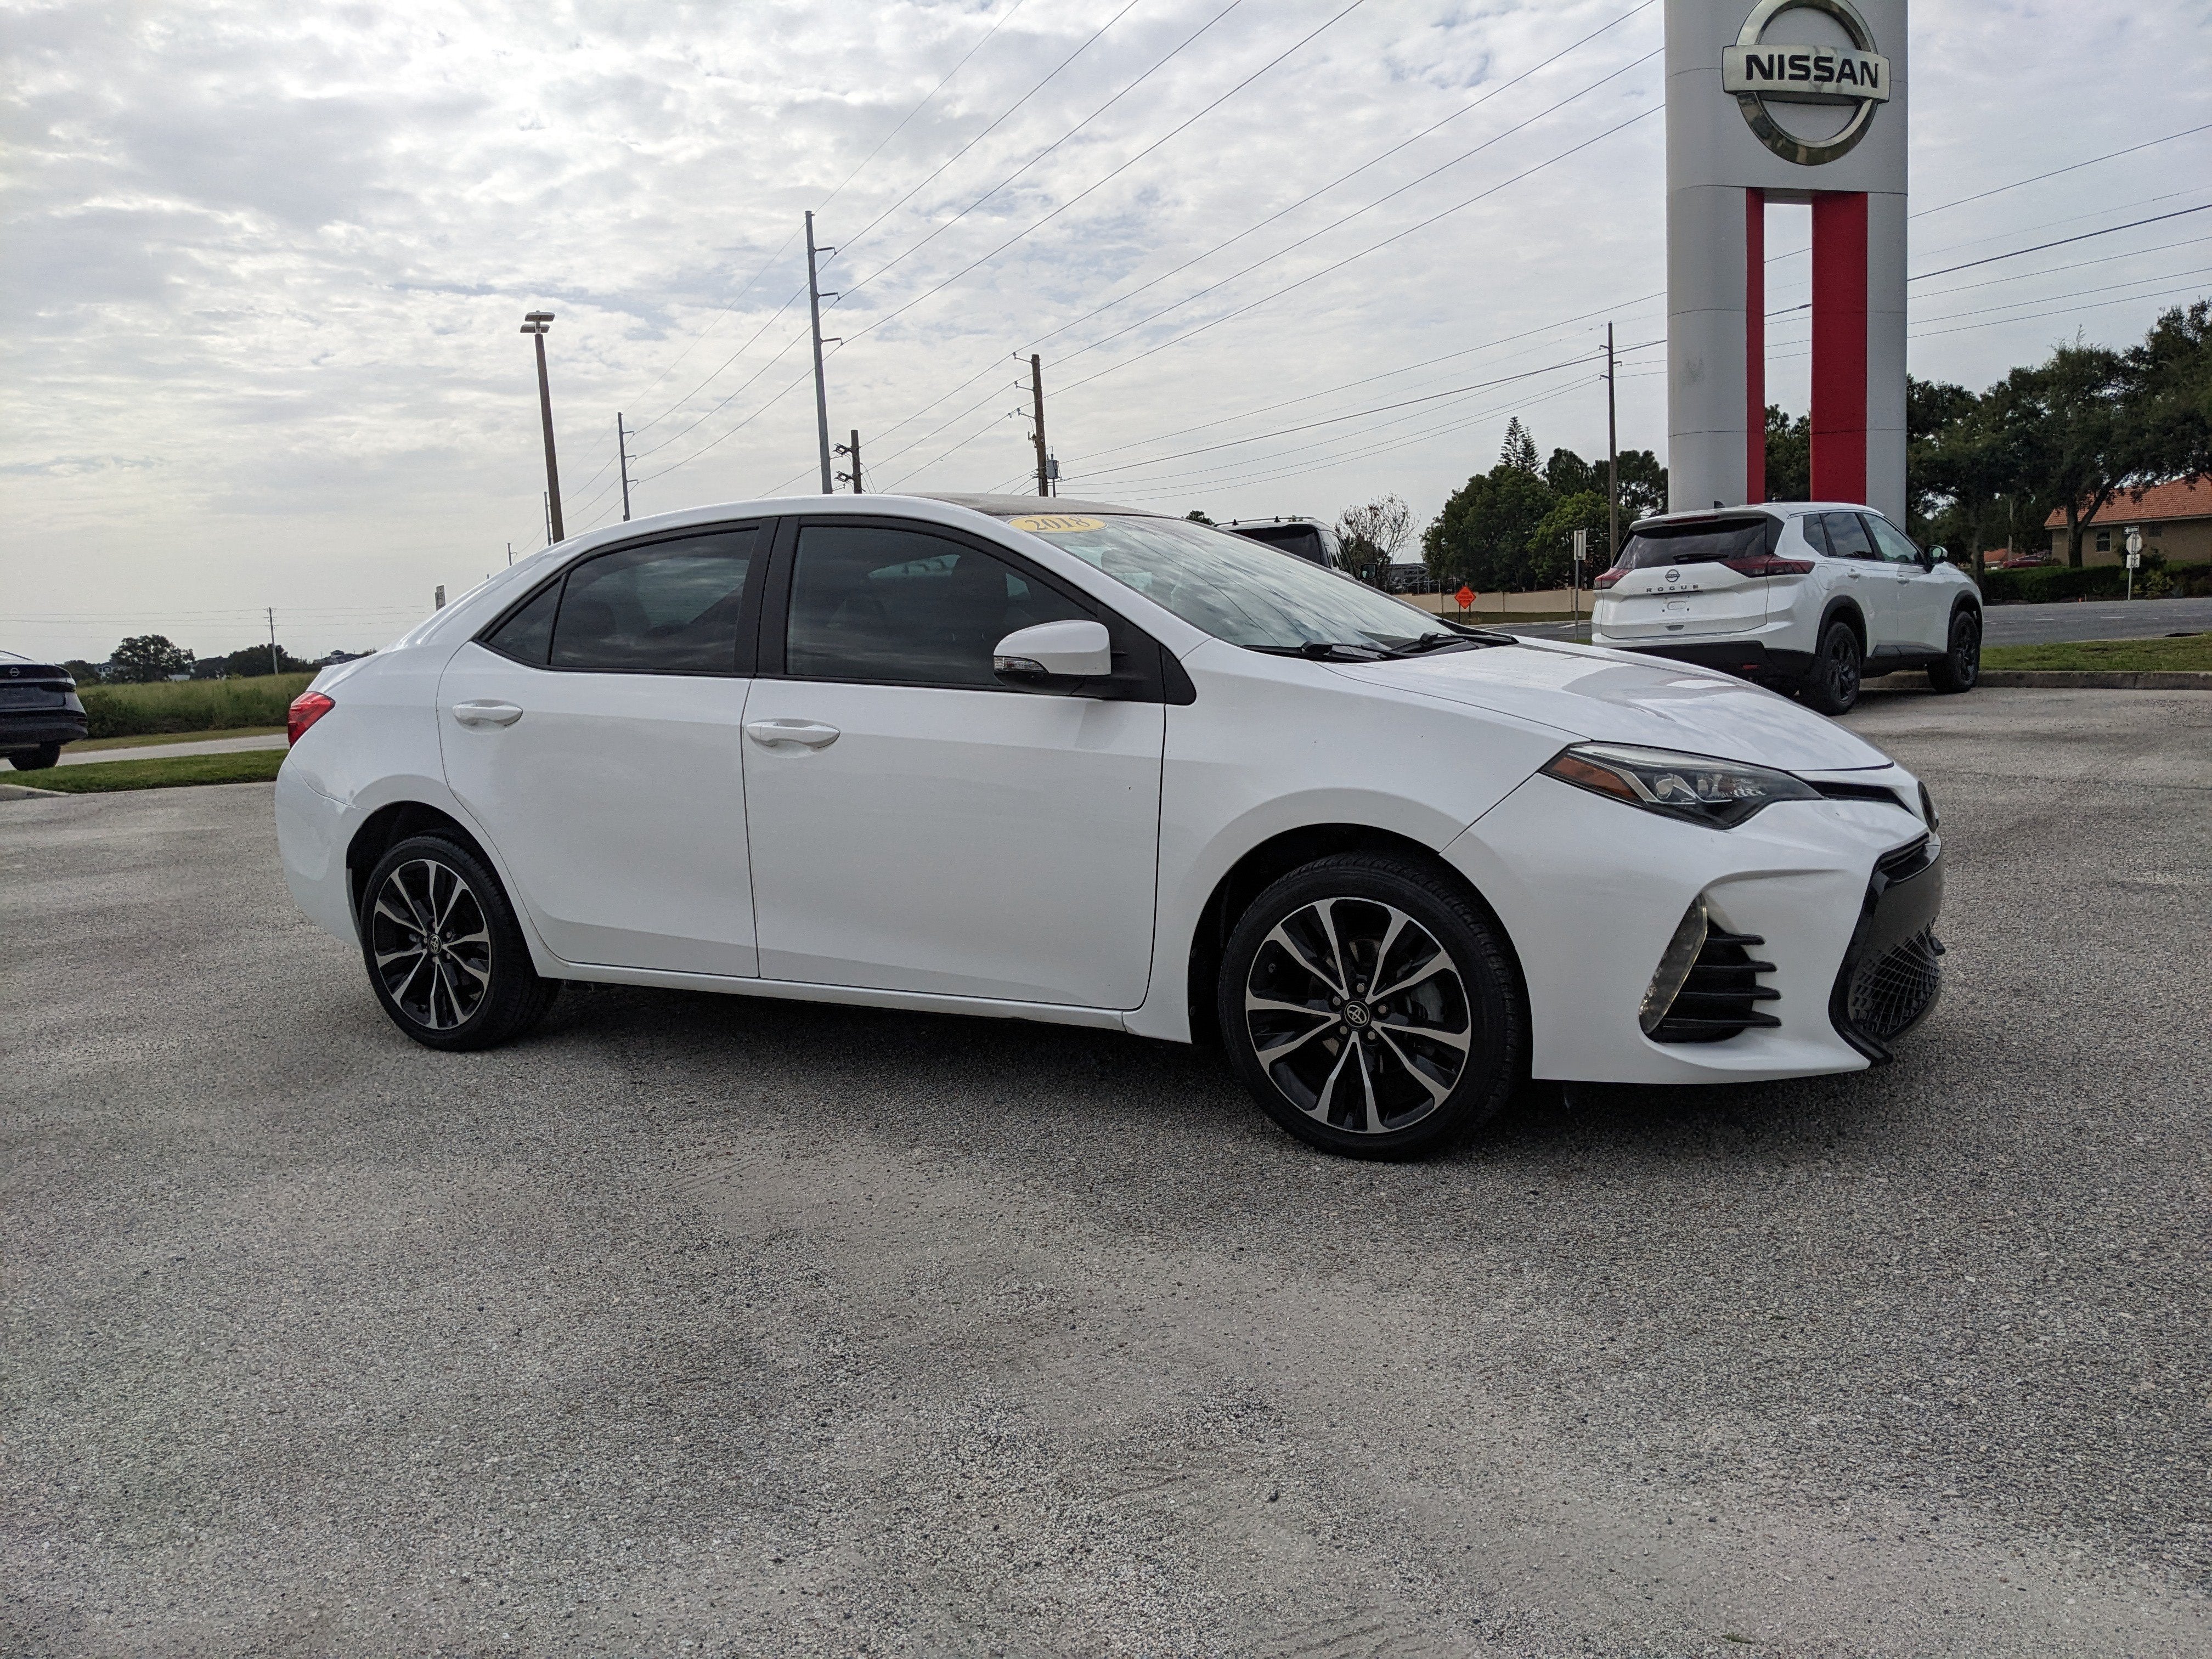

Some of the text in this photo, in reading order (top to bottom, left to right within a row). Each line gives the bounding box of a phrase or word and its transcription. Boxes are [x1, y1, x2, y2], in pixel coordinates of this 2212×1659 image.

[1746, 54, 1879, 89] NISSAN
[1025, 517, 1091, 531] 2018
[1646, 584, 1699, 592] ROGUE
